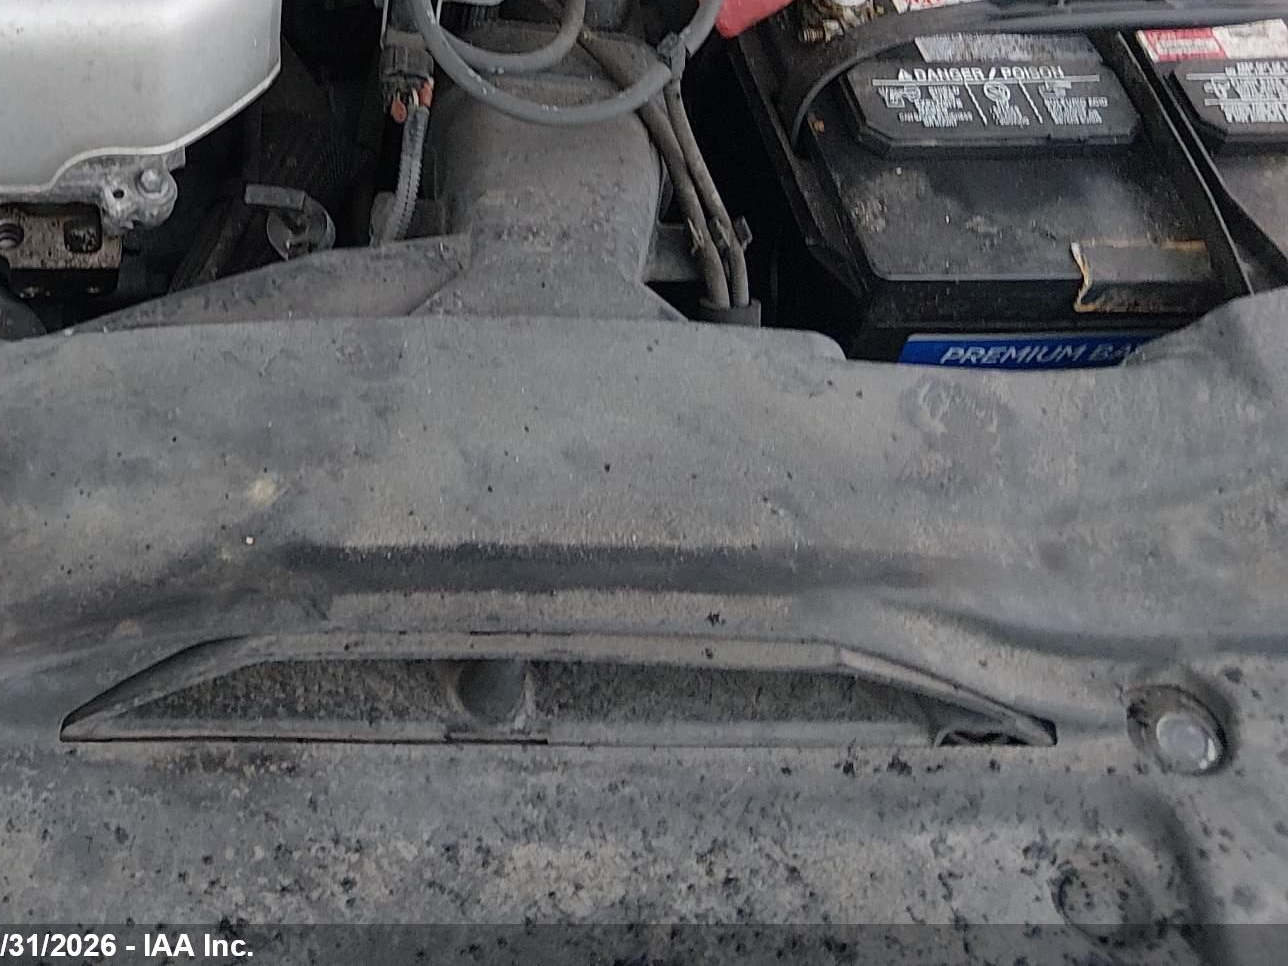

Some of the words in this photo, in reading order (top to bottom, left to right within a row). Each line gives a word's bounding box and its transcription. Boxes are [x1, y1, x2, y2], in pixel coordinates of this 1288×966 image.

[913, 67, 984, 82] DANGER
[1000, 65, 1065, 80] POISON
[939, 345, 1086, 365] PREMIUM
